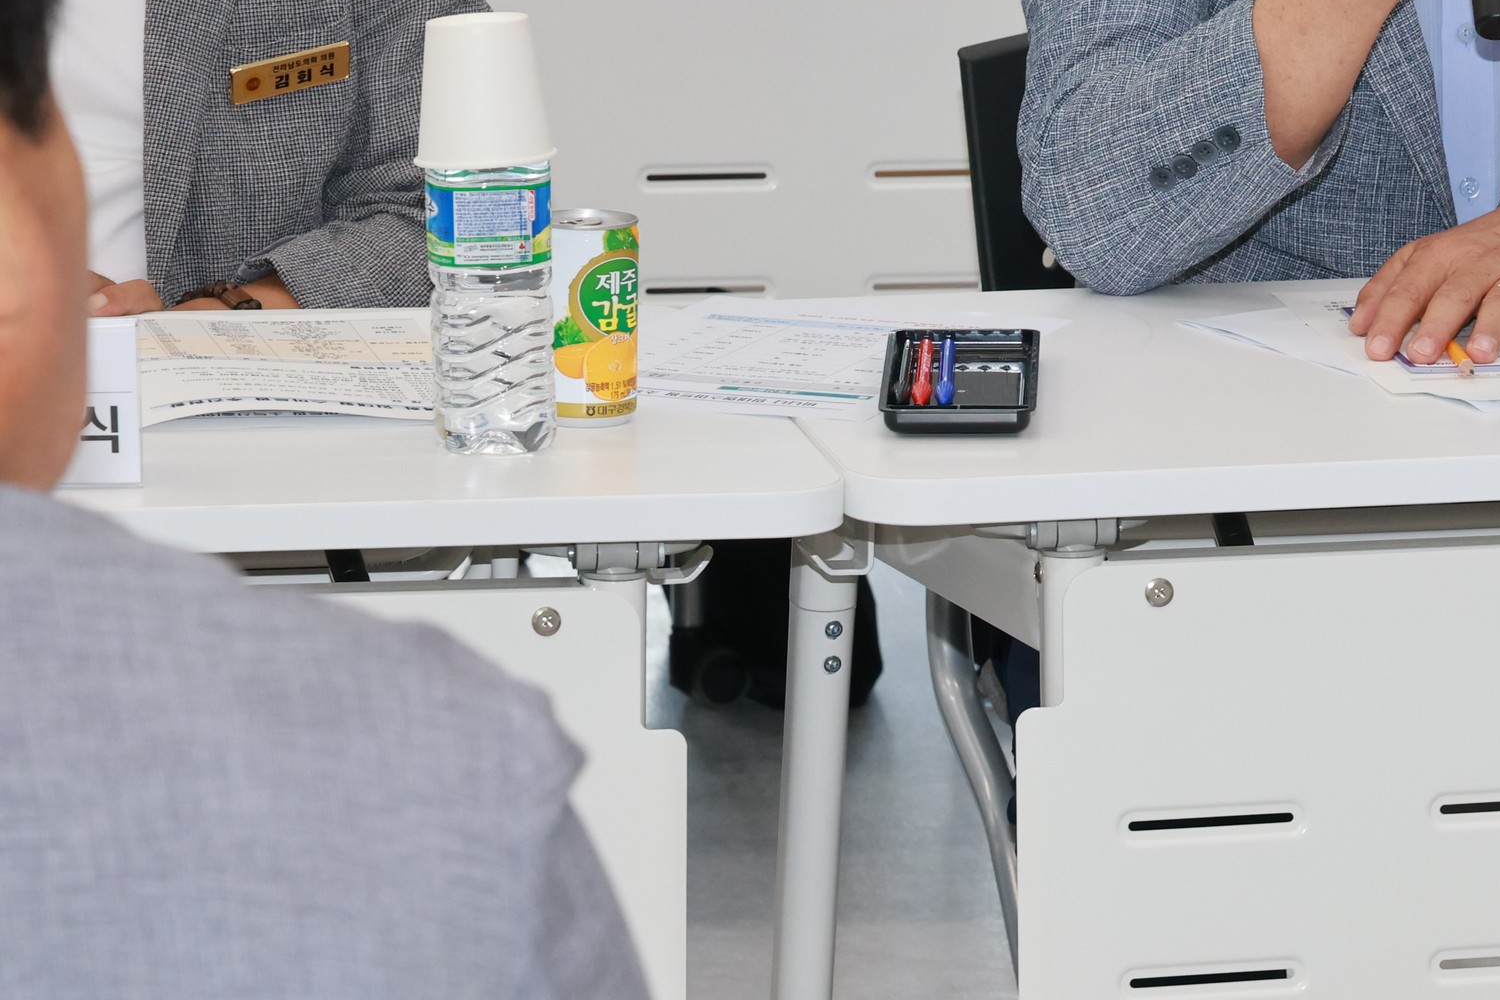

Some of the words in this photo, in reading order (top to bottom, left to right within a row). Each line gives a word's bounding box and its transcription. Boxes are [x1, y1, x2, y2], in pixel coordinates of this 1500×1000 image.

[595, 268, 637, 295] 제주
[592, 293, 638, 331] 감귤
[80, 405, 120, 454] 식
